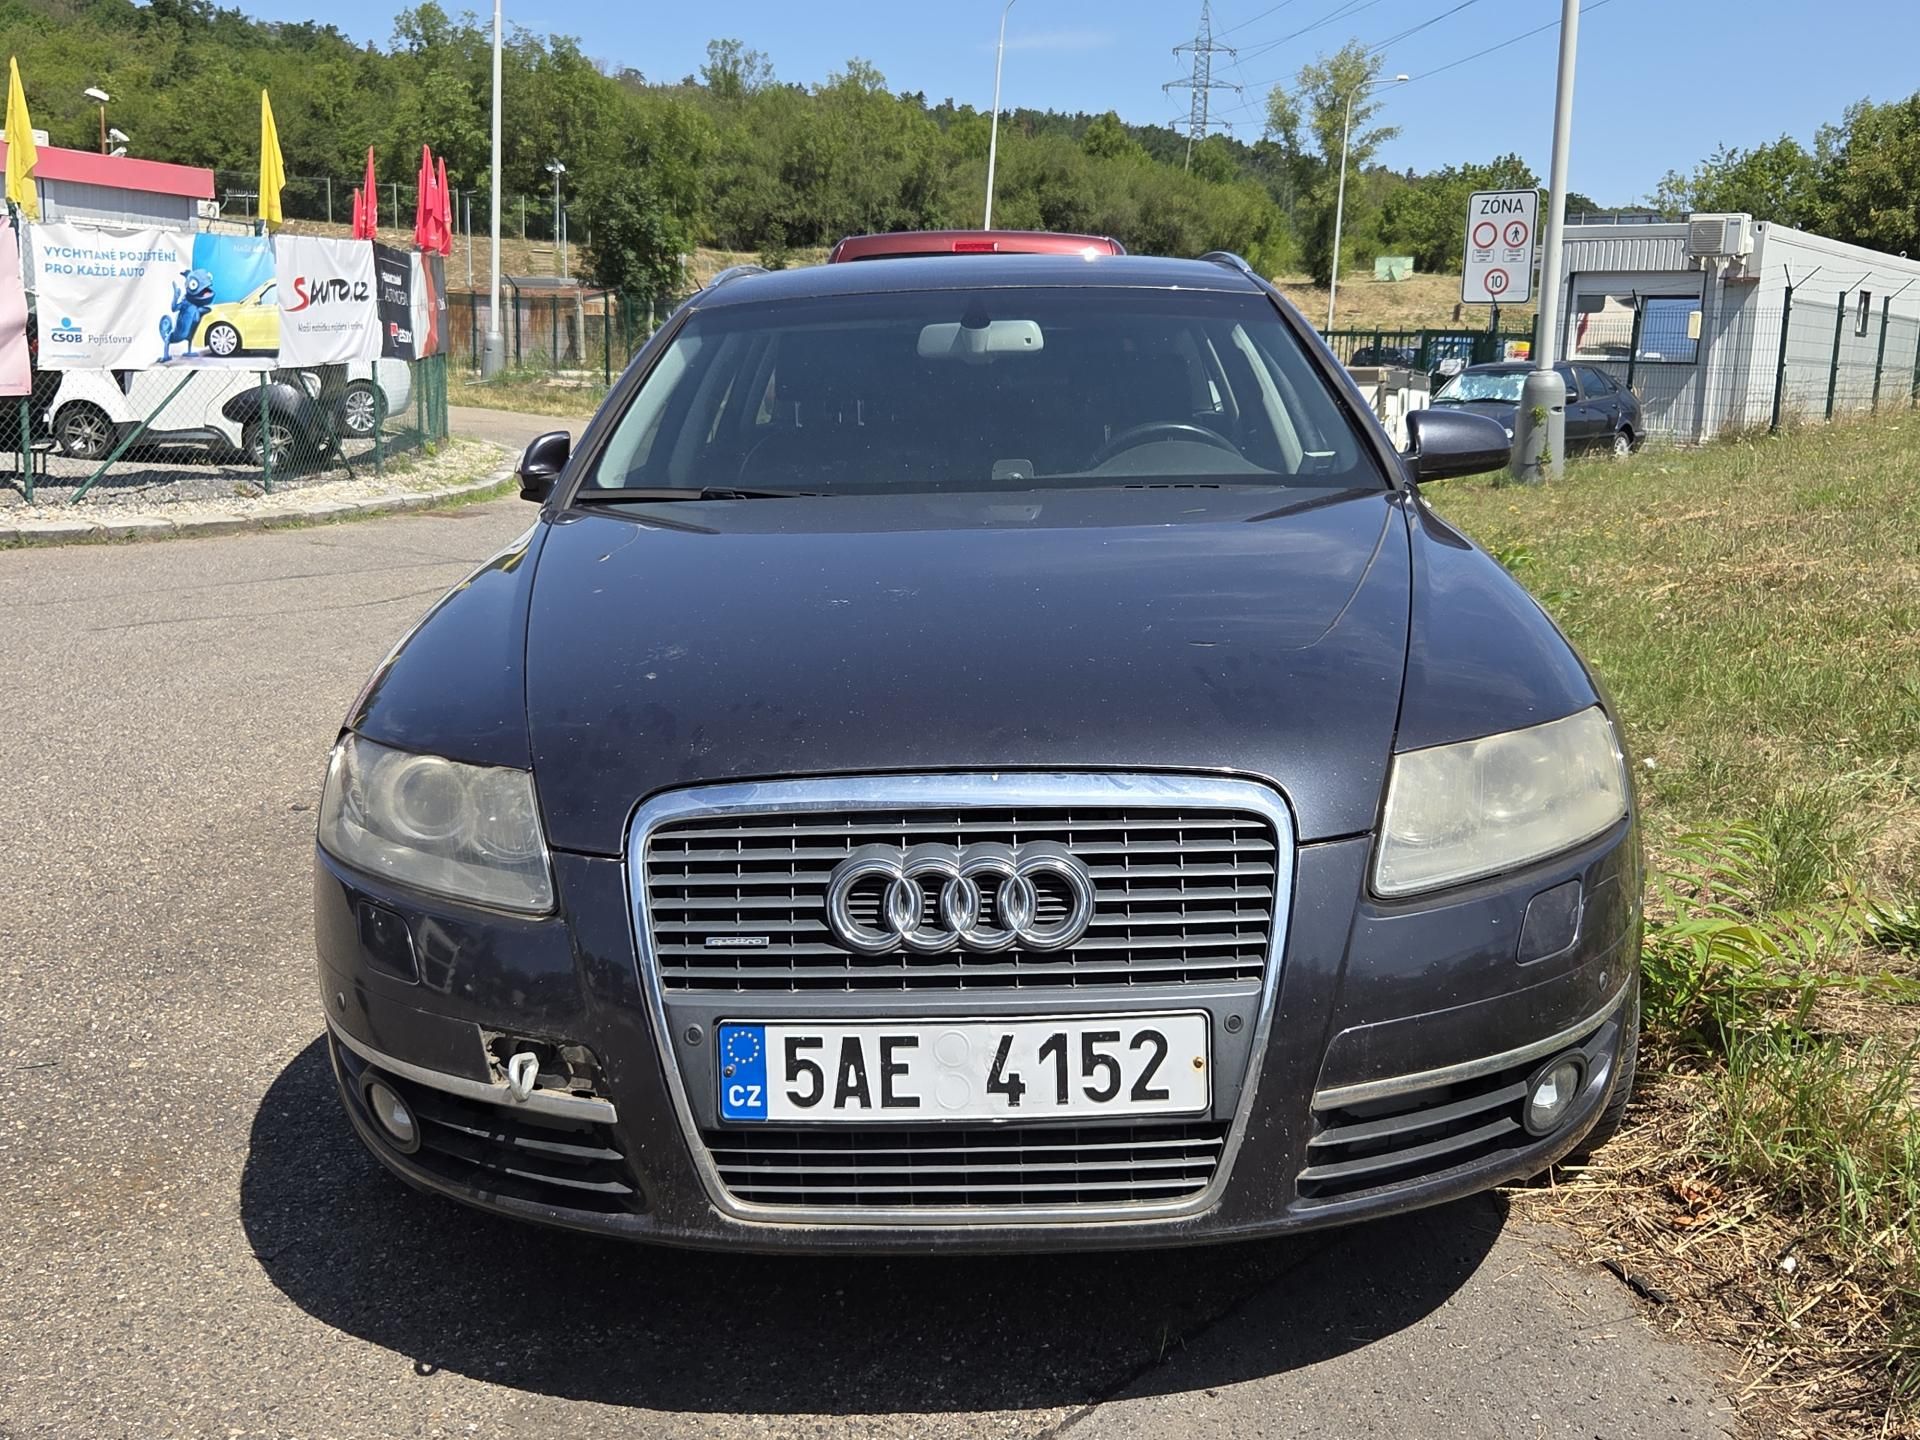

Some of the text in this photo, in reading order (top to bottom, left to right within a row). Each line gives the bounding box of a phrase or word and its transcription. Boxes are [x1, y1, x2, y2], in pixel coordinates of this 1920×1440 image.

[1480, 196, 1524, 214] ZÓNA
[43, 246, 177, 262] VYCHYTANÉ POJIŠTĚNÍ
[44, 263, 145, 277] PRO KAŽDÉ AUTO
[1490, 275, 1503, 289] 10
[51, 333, 83, 343] ČSOB
[711, 937, 762, 946] quattro
[784, 1029, 1170, 1109] 5AE 4152
[728, 1084, 762, 1107] CZ
